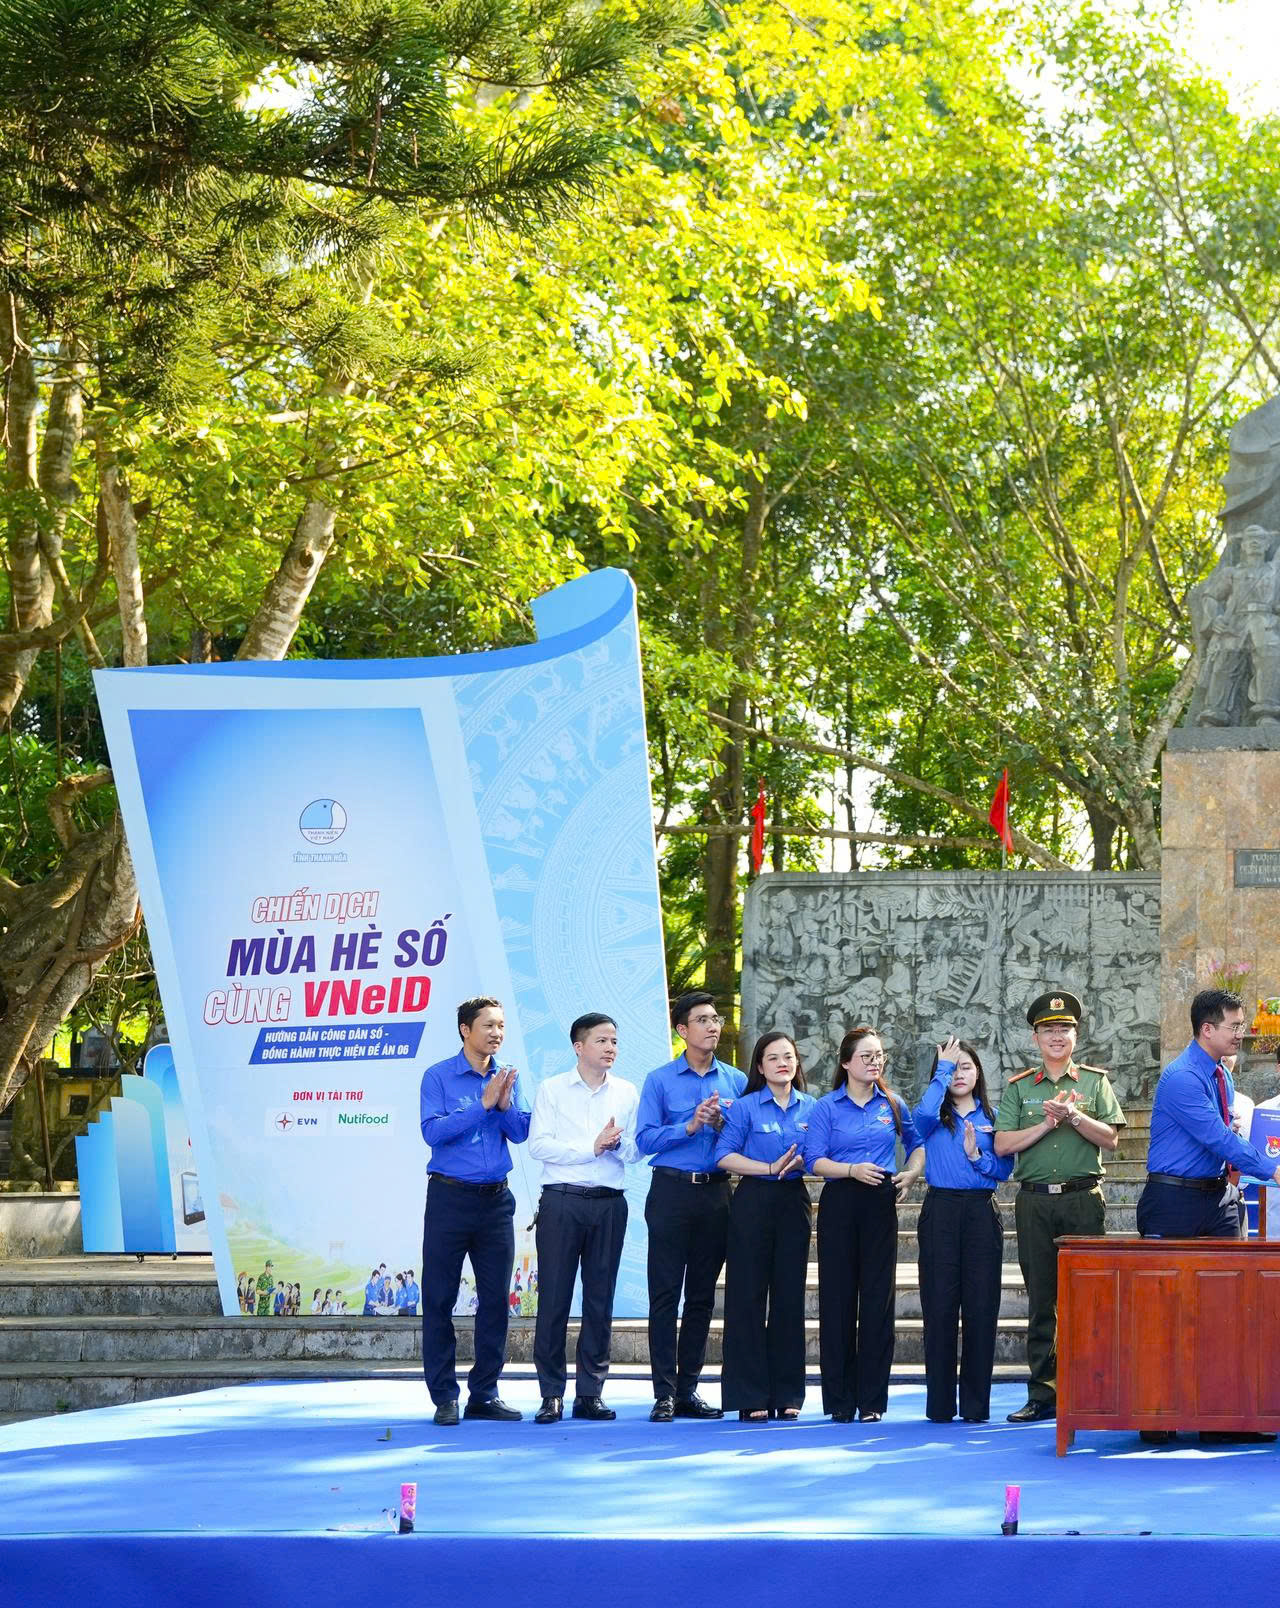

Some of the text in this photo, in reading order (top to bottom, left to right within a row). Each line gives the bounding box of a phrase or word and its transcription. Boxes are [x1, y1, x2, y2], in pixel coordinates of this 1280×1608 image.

[252, 887, 379, 924] CHIẾN DỊCH
[226, 914, 452, 976] MÙA HÈ SỐ
[204, 976, 432, 1025] CÙNG VNeID
[299, 1028, 319, 1042] DẪN
[321, 1029, 346, 1041] CÔNG
[348, 1028, 368, 1040] DÂN
[370, 1025, 384, 1039] SỐ
[290, 1046, 316, 1059] HÀNH
[318, 1046, 342, 1060] THỰC
[344, 1045, 365, 1059] HIỆN
[397, 1044, 409, 1055] 06
[293, 1090, 364, 1102] ĐƠN VỊ TÀI TRỢ
[297, 1118, 318, 1126] EVN
[338, 1114, 389, 1124] Nutifood
